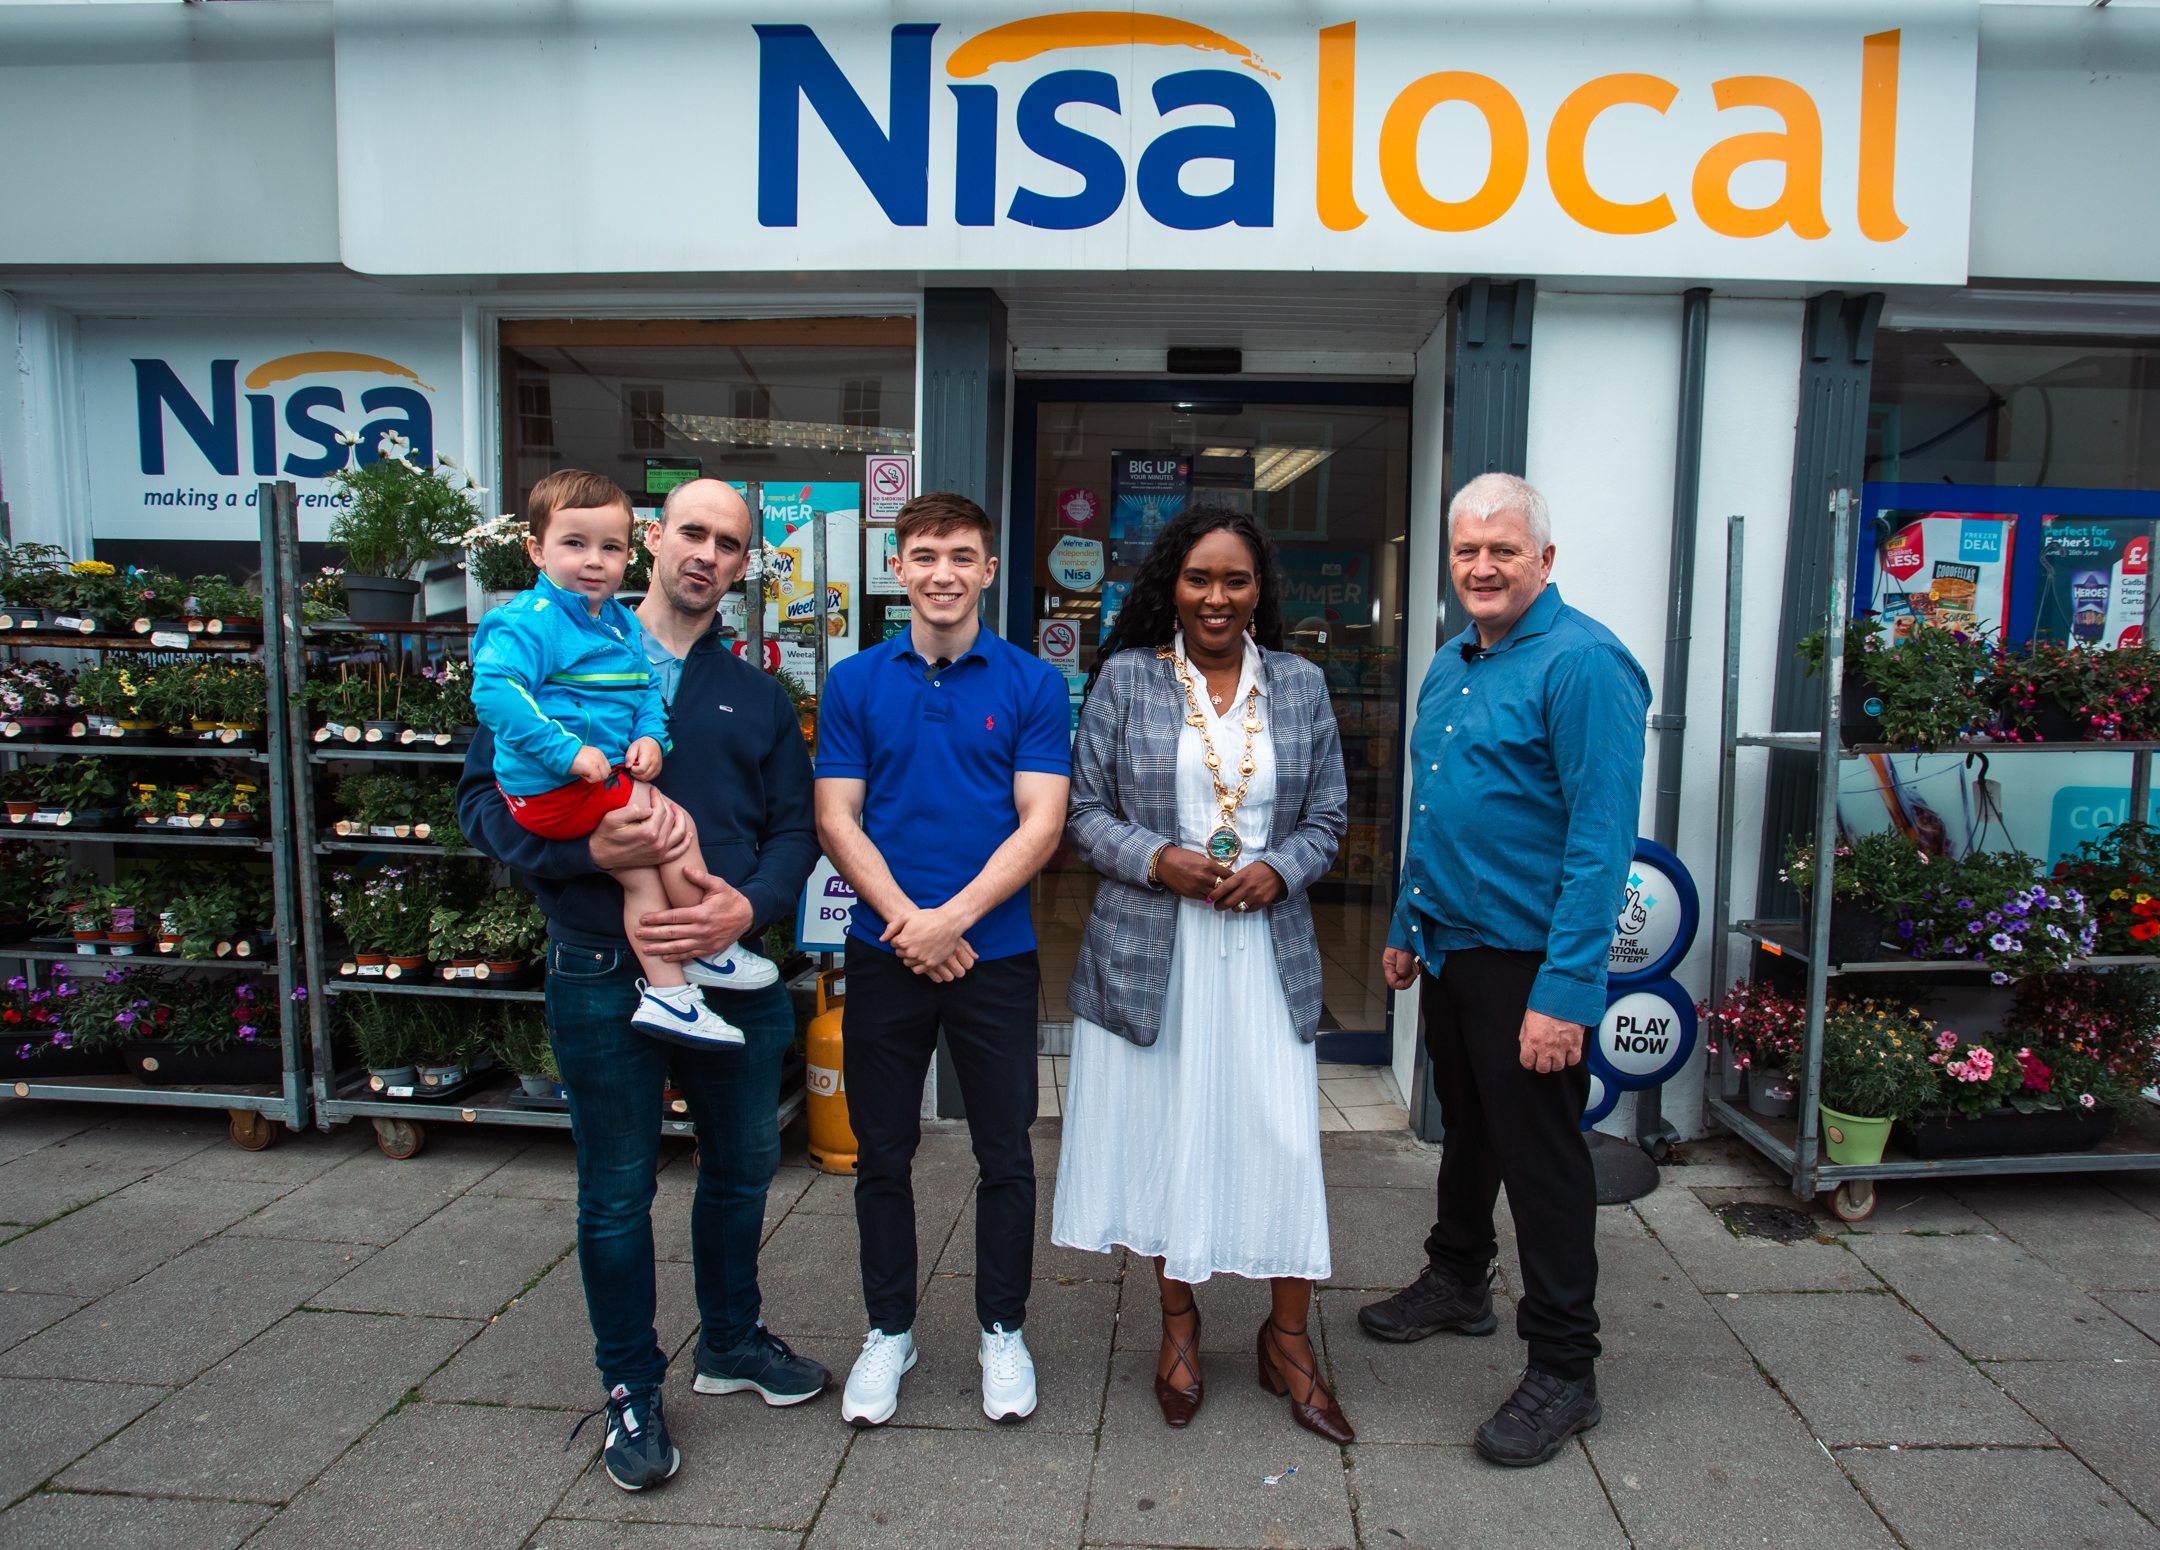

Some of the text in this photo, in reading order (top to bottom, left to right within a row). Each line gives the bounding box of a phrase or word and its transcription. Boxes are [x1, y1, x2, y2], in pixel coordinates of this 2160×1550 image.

[751, 16, 1909, 243] Nisa local
[130, 356, 434, 479] Nisa
[1129, 461, 1152, 474] BIG
[1157, 461, 1176, 474] UP
[144, 488, 353, 511] making a drence
[763, 504, 812, 521] MMER
[2044, 526, 2109, 536] Perfect for
[1964, 539, 1998, 551] DEAL
[2092, 537, 2116, 550] Day
[1056, 550, 1100, 558] independent
[1064, 568, 1091, 580] Nisa
[1936, 564, 1976, 582] GOODFELLA'S
[1283, 578, 1362, 605] MMER
[2074, 588, 2108, 598] HEROES
[1619, 938, 1639, 947] THE
[1610, 946, 1650, 956] ATIONAL
[1609, 954, 1646, 963] OTTERY
[1616, 1015, 1671, 1036] PLAY
[1614, 1034, 1669, 1054] NOW
[808, 1070, 831, 1089] FLO
